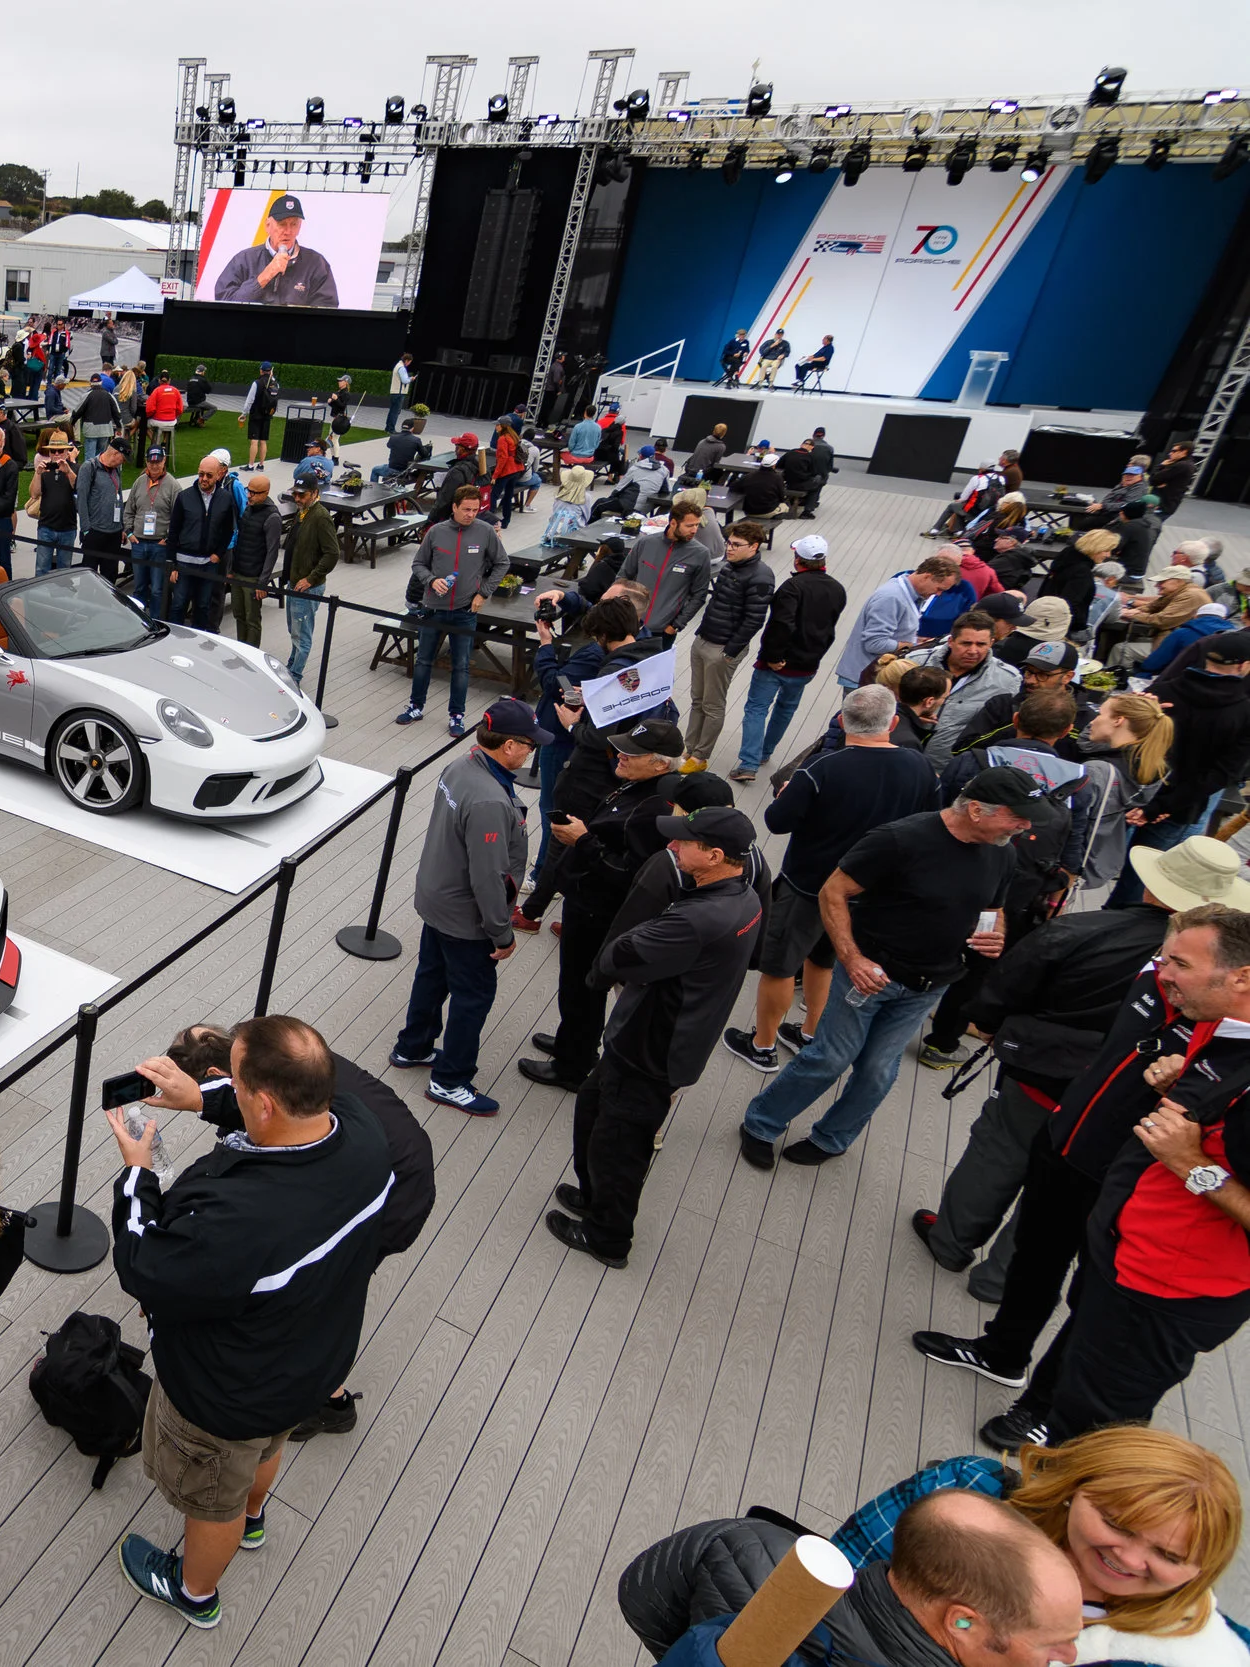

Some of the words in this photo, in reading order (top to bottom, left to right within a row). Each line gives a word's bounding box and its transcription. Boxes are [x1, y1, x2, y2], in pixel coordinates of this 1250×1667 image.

[816, 233, 887, 241] PORSCHE
[910, 225, 958, 255] 70
[161, 282, 179, 290] EXIT
